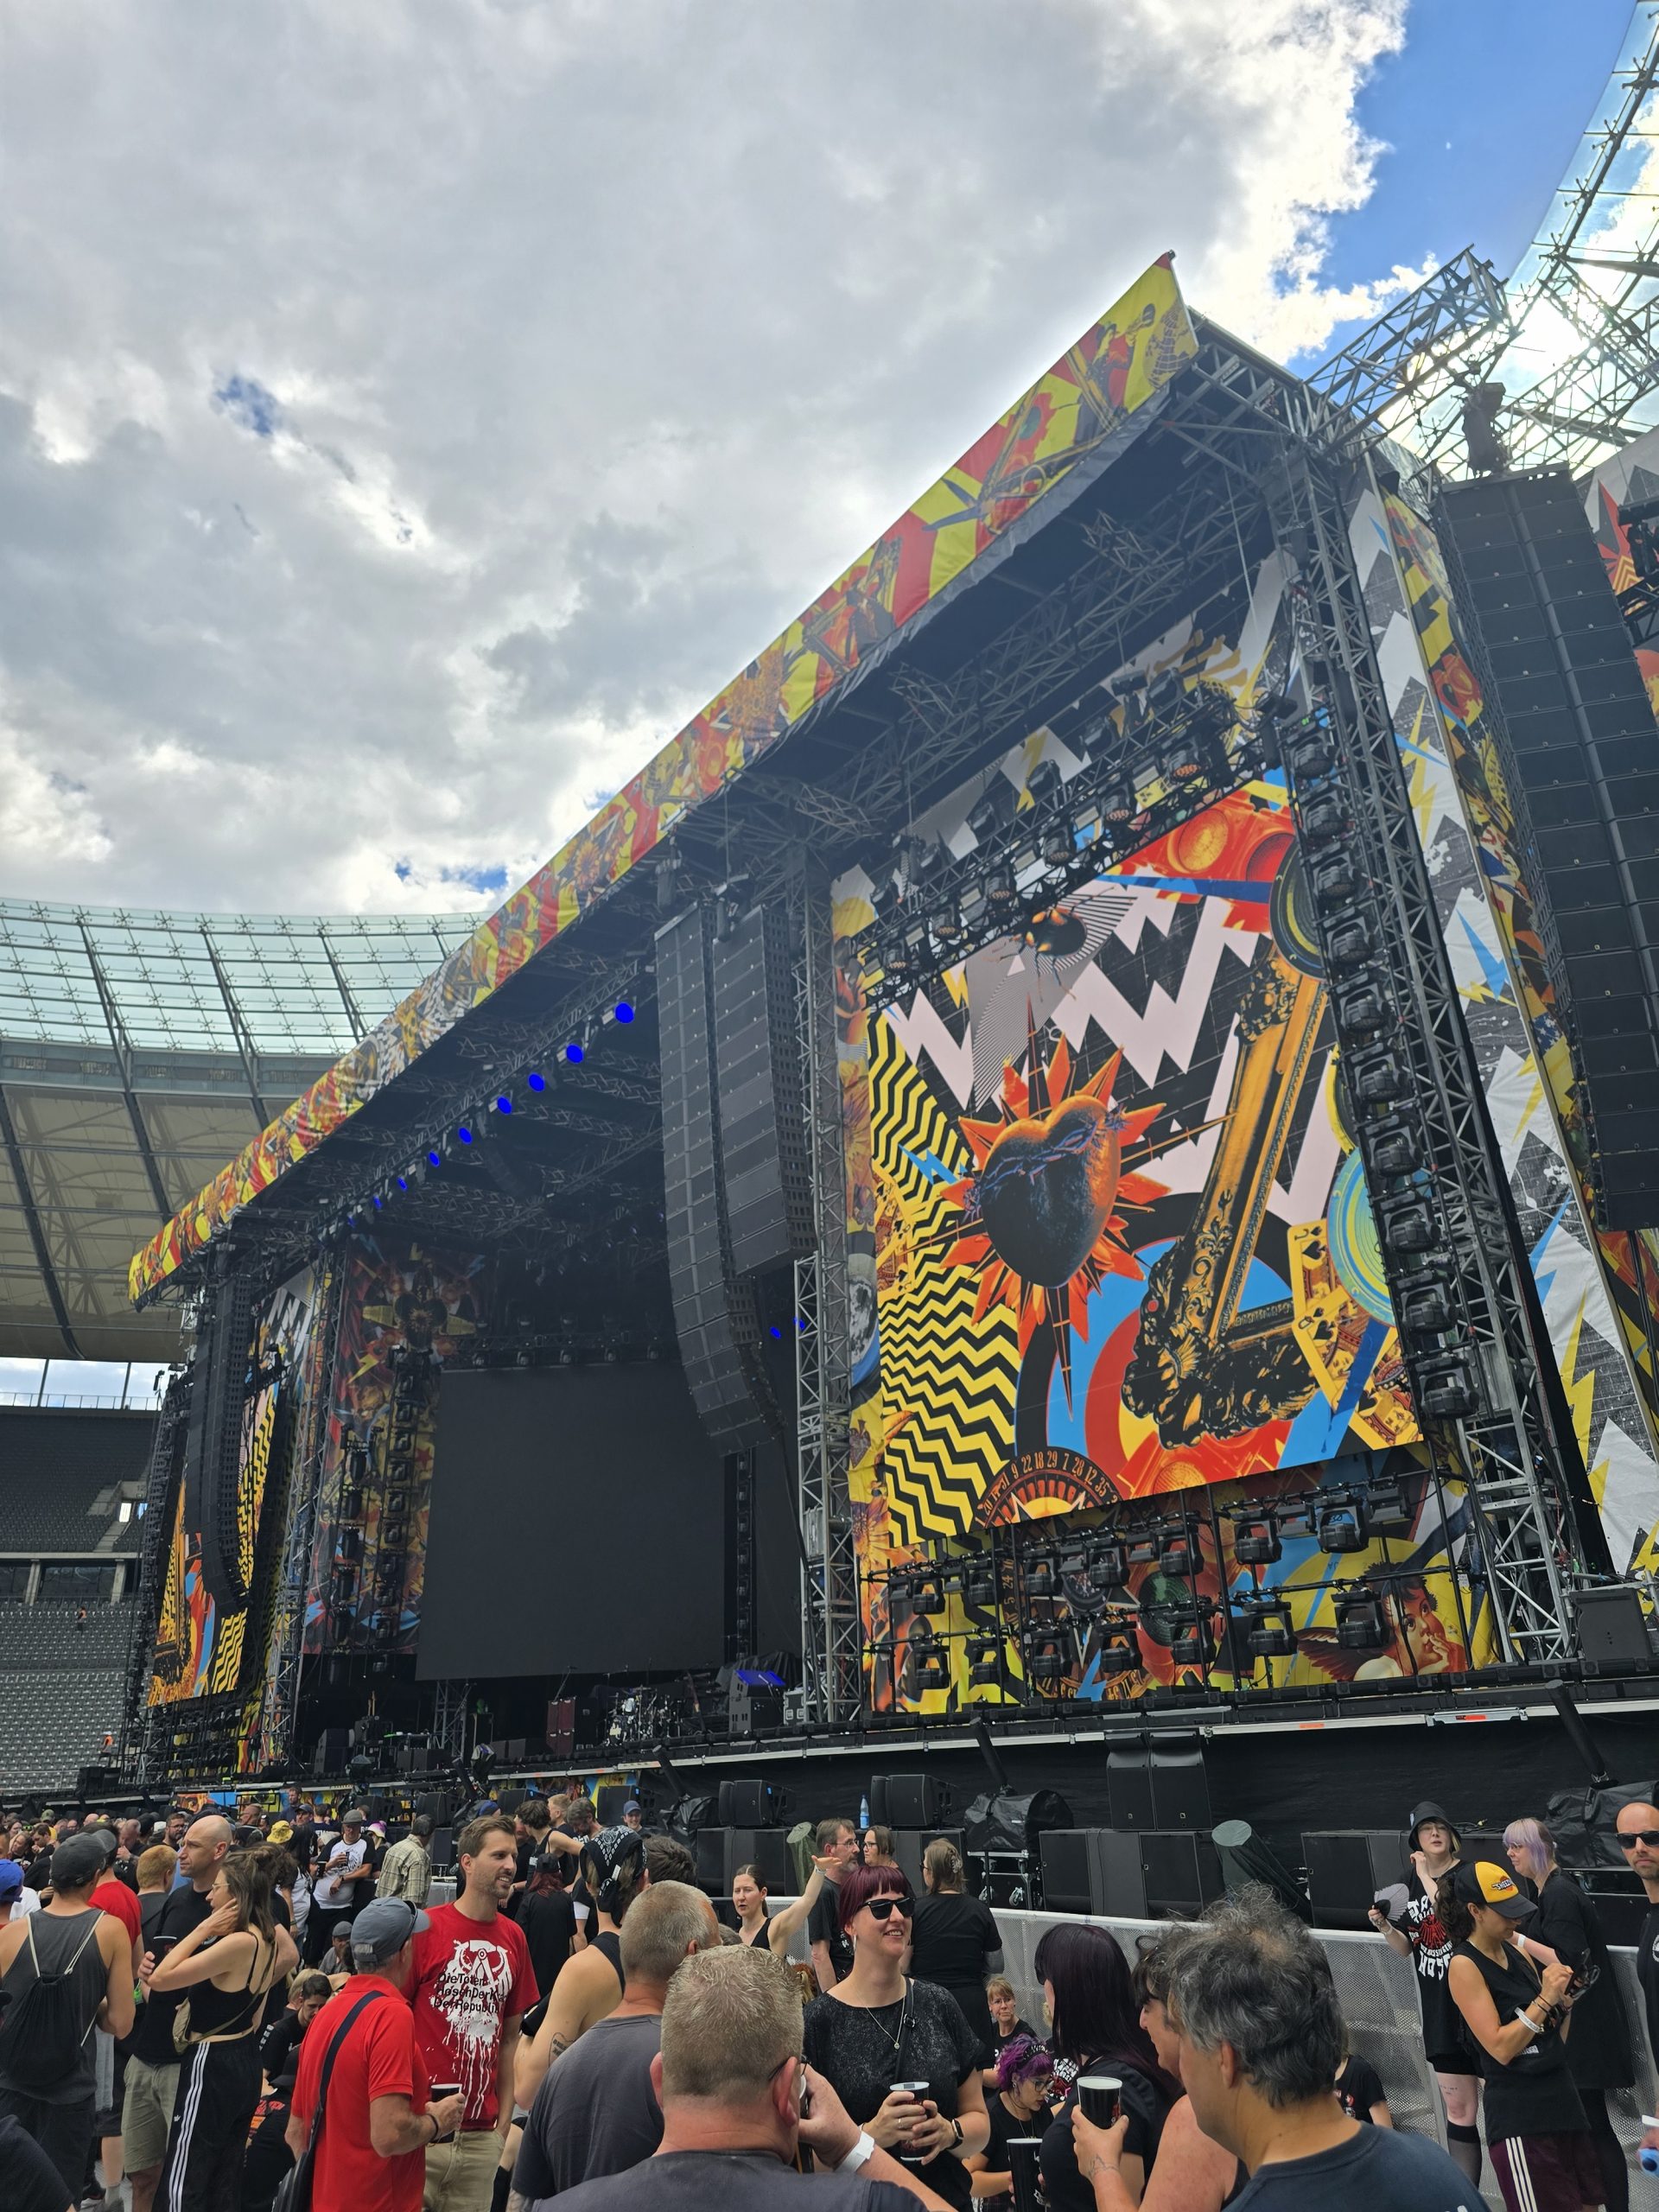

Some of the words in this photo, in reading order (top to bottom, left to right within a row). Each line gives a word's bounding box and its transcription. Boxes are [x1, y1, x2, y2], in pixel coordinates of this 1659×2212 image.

[1011, 1462, 1020, 1479] 9
[1021, 1454, 1032, 1474] 22
[1034, 1451, 1044, 1470] 18
[1046, 1451, 1058, 1468] 29
[1062, 1452, 1070, 1471] 7
[1071, 1457, 1085, 1477] 28
[1084, 1465, 1097, 1486] 12
[1095, 1477, 1111, 1497] 35
[1001, 1574, 1014, 1590] 24
